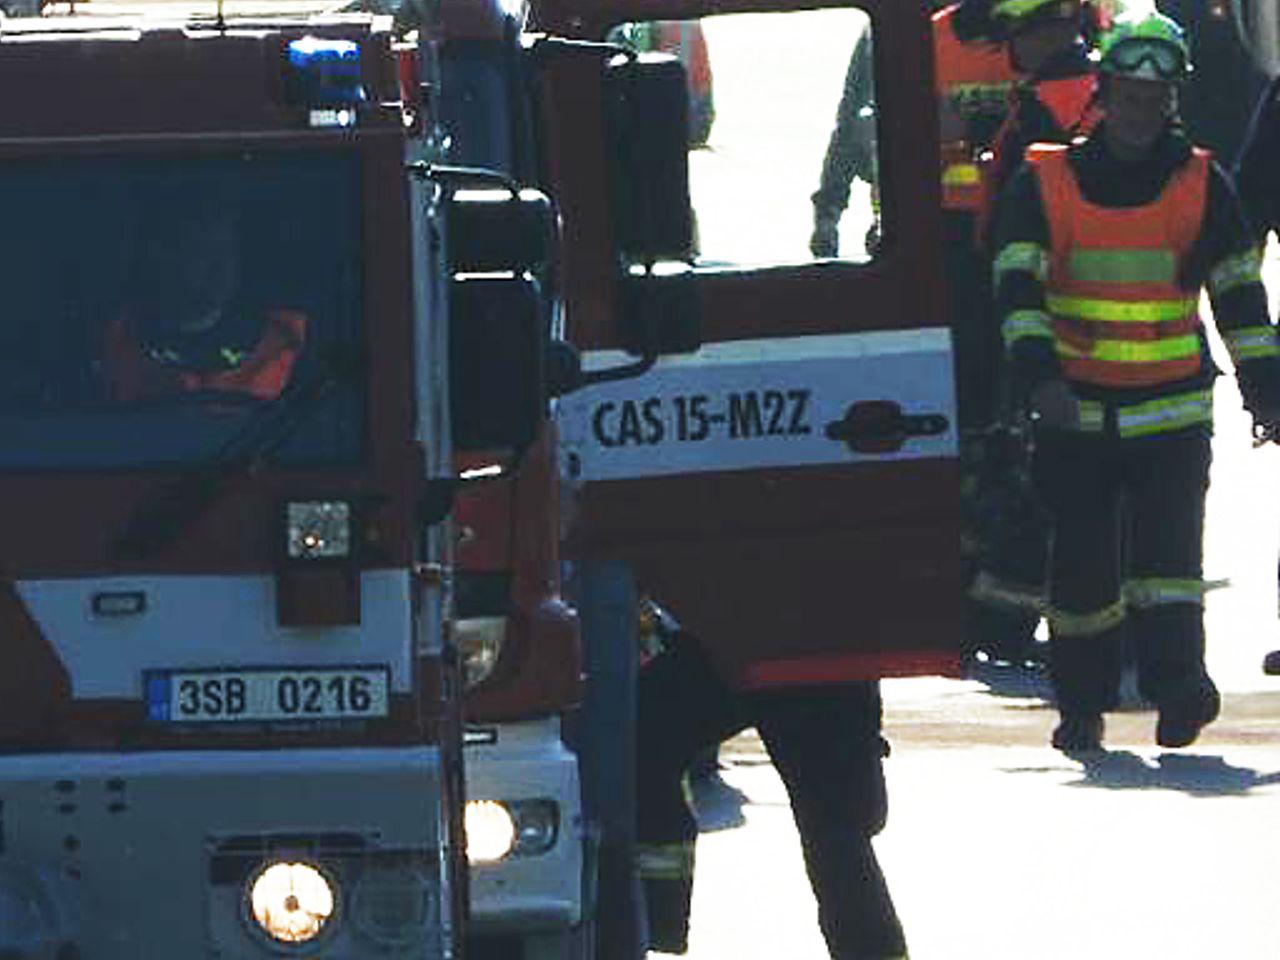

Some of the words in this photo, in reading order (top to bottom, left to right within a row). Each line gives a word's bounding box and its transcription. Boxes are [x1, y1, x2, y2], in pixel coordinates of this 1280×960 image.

[593, 397, 664, 448] CAS
[677, 390, 812, 441] 15-M2Z
[179, 678, 245, 715] 3SB
[277, 676, 371, 714] 0216
